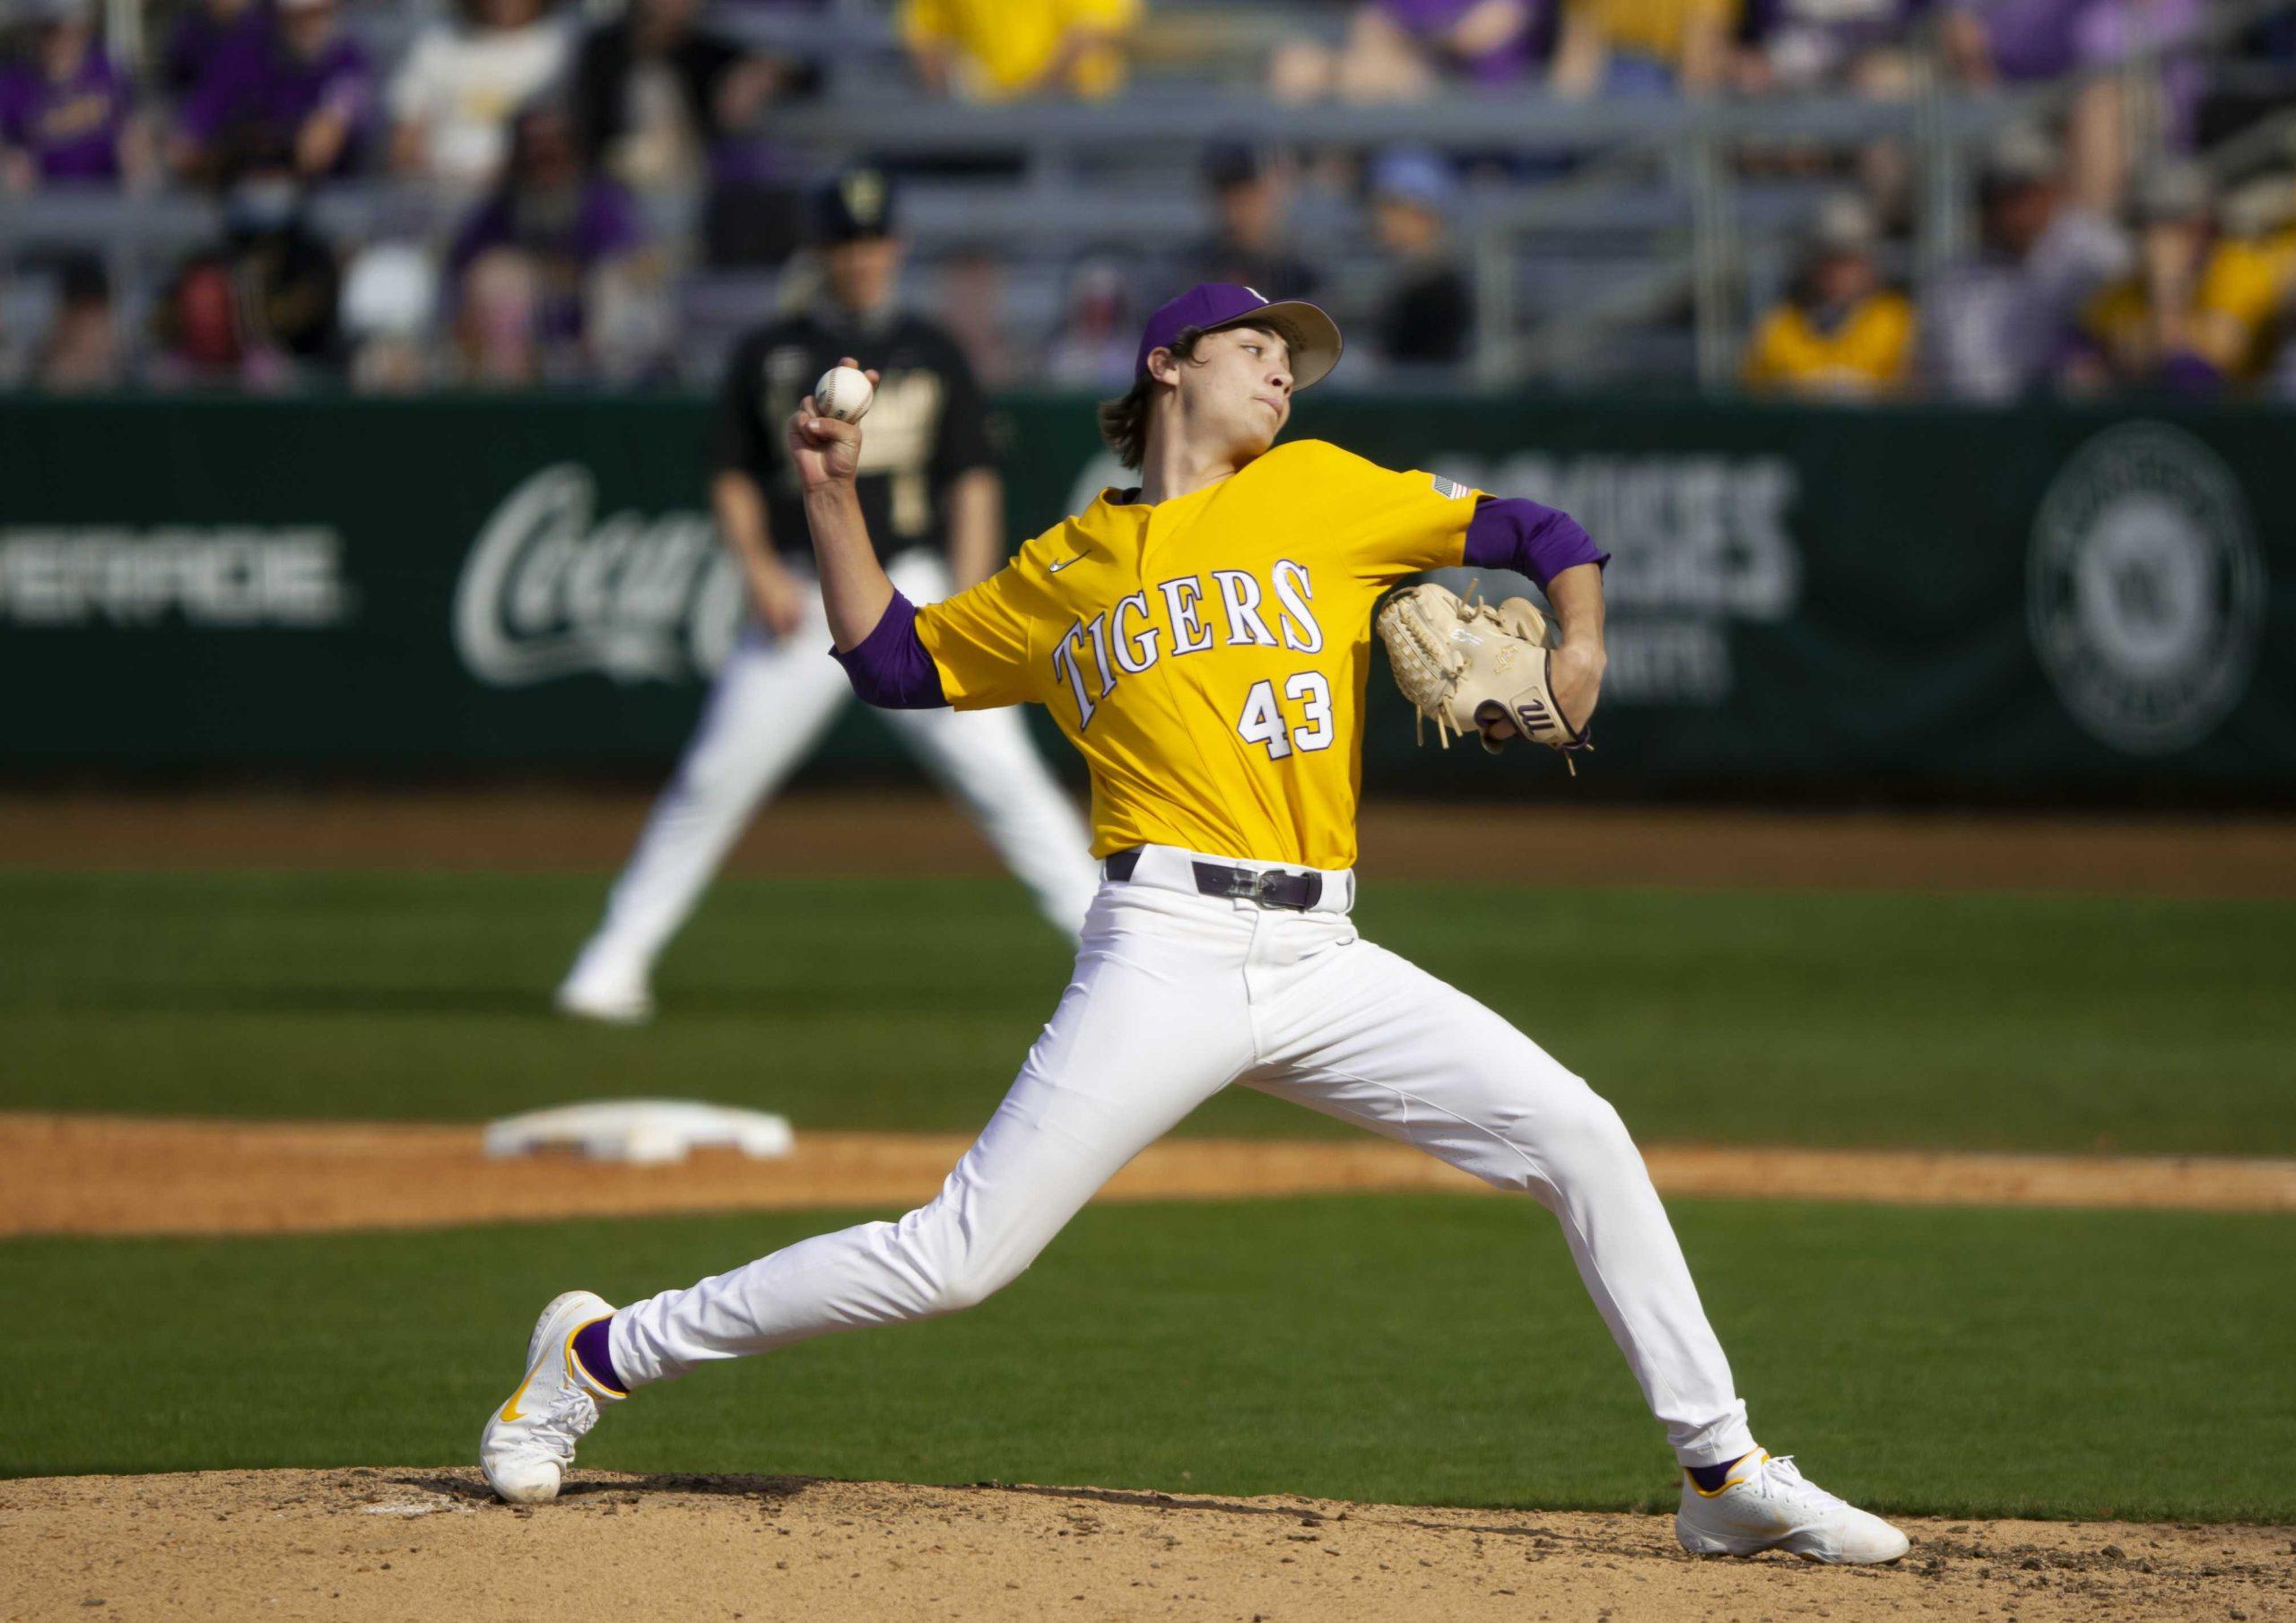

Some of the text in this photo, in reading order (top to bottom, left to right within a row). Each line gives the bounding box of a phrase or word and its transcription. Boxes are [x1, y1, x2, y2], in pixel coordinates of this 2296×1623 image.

[0, 524, 341, 624] ERADE
[1051, 558, 1324, 733] TIGERS
[1236, 669, 1335, 761] 43
